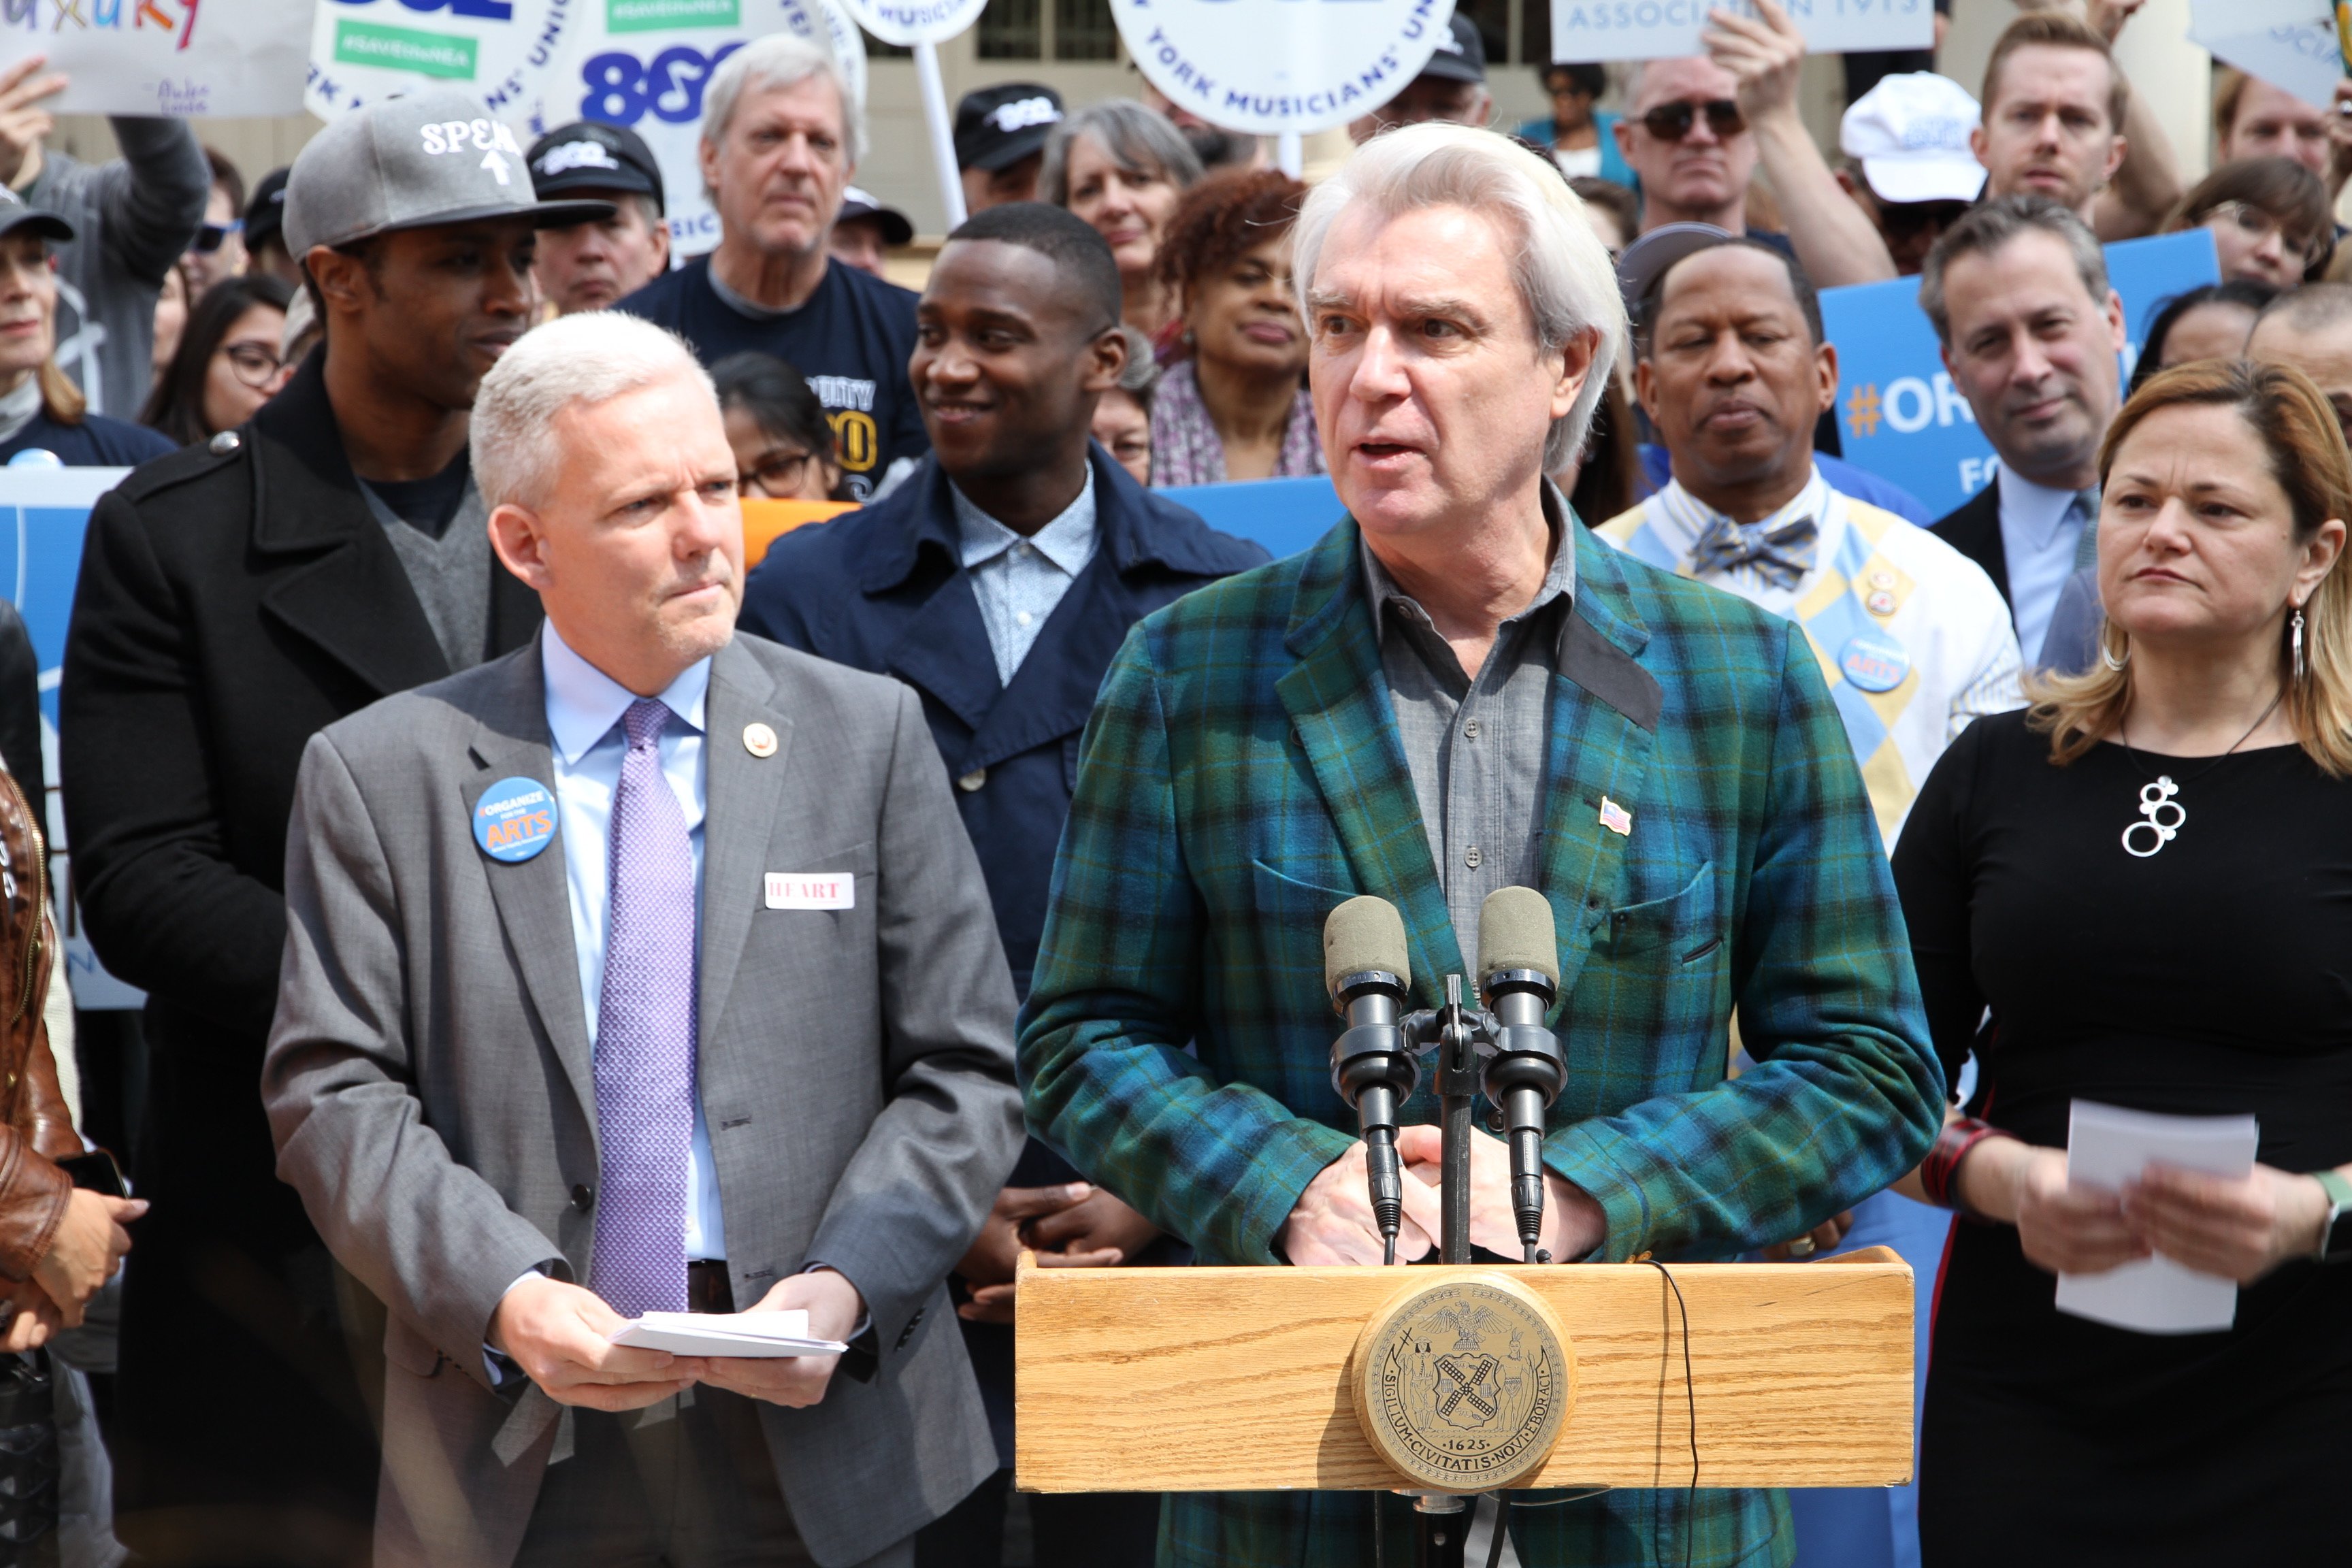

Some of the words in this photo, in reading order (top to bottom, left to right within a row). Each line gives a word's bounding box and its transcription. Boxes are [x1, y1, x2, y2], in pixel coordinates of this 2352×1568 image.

[1147, 25, 1217, 99] YORK
[487, 810, 552, 848] ARTS
[1411, 1440, 1492, 1471] CIVITATIS
[1494, 1435, 1529, 1464] NOVI
[1524, 1375, 1551, 1435] EBORACI
[1448, 1439, 1486, 1450] 1625
